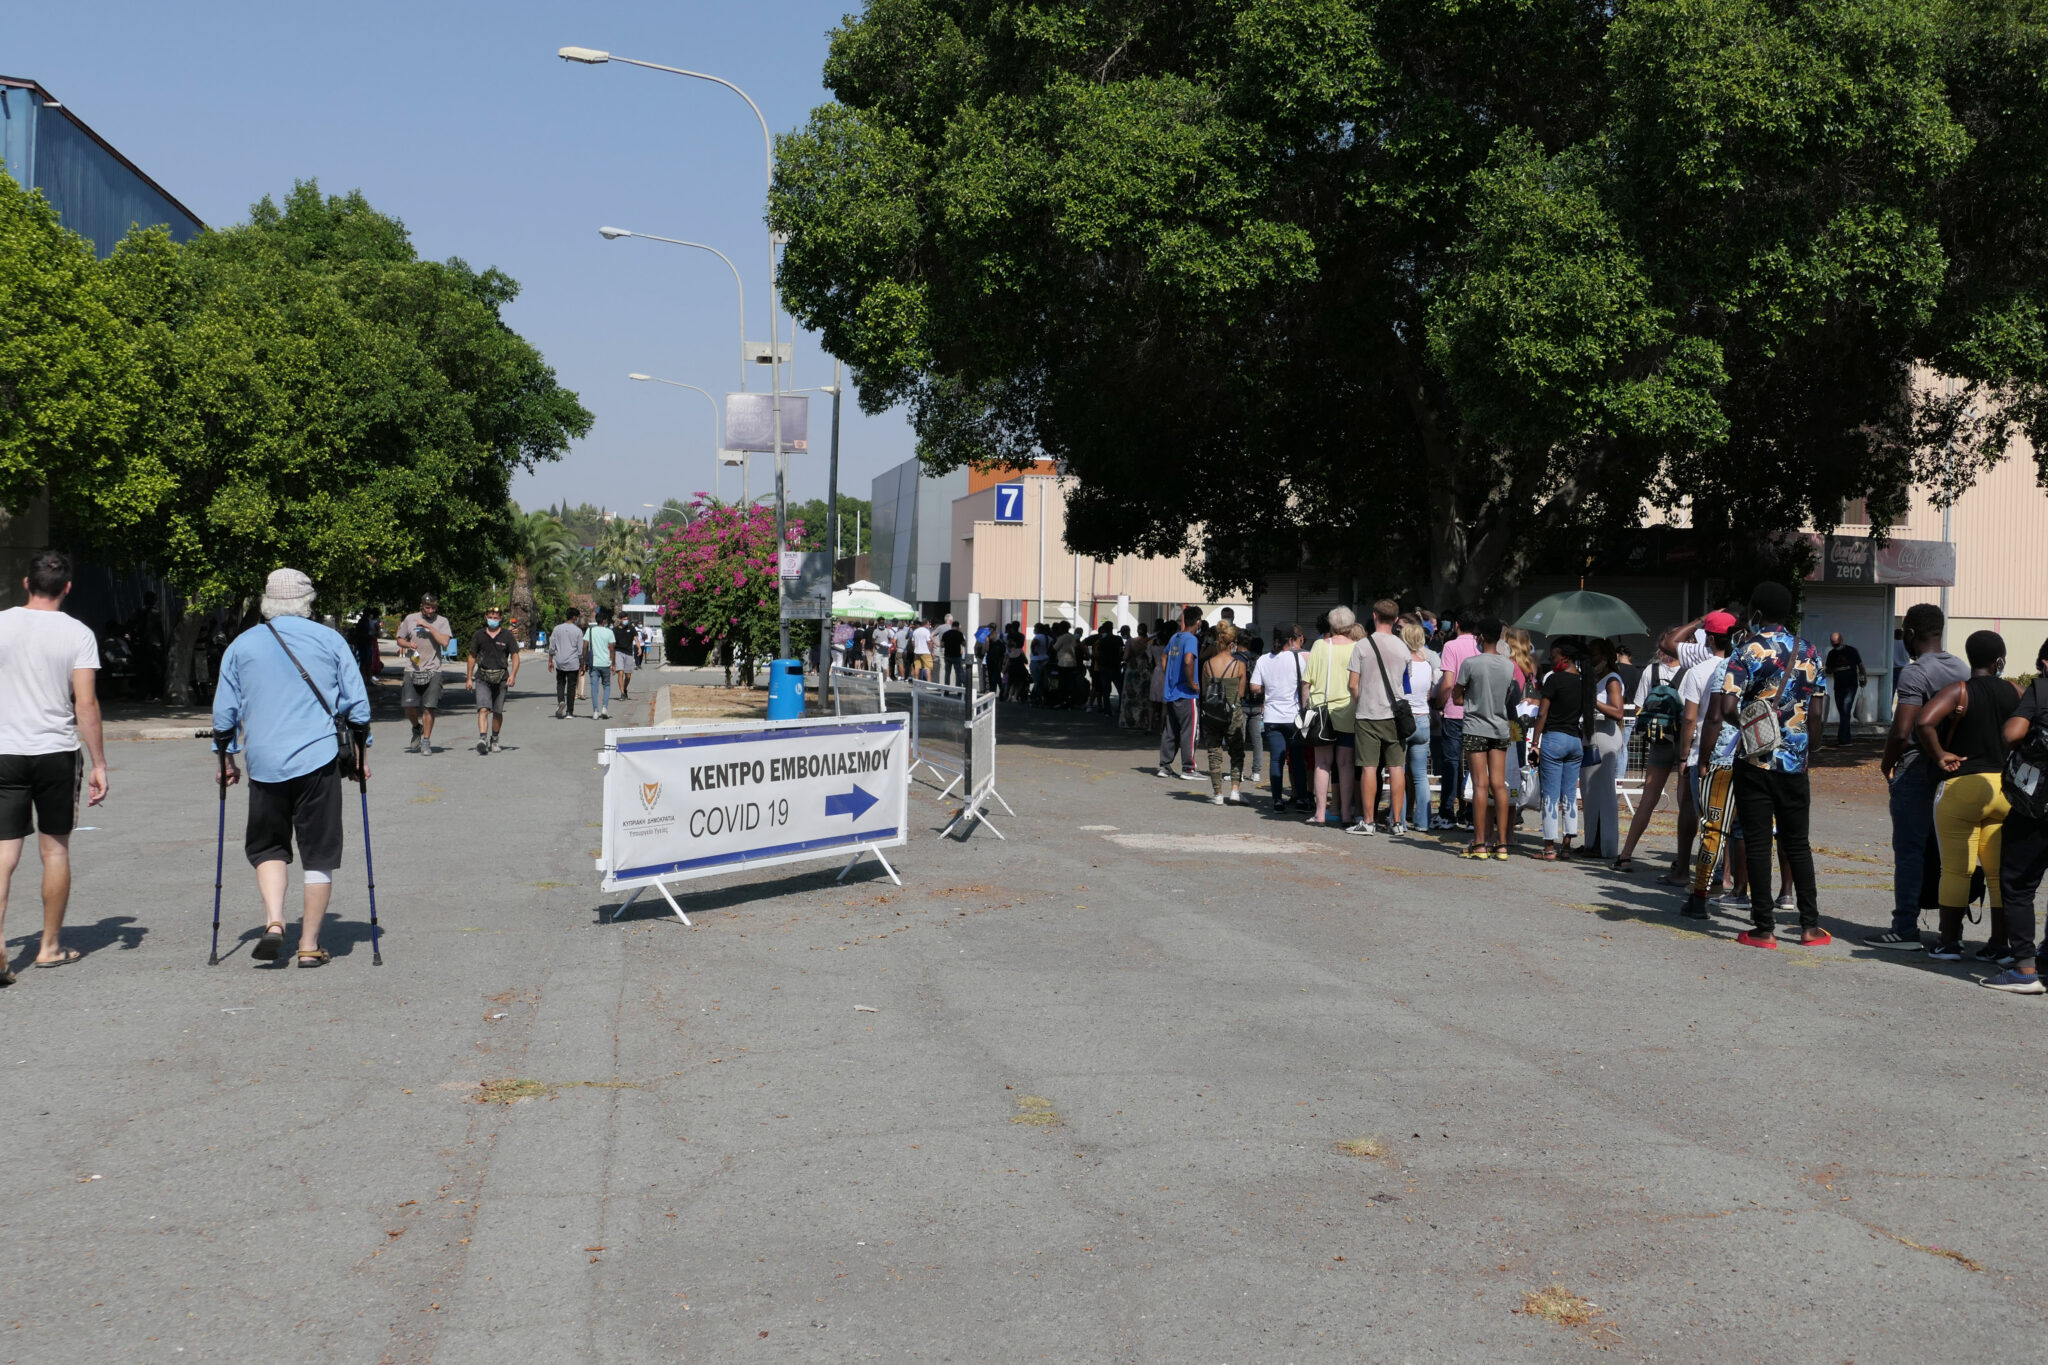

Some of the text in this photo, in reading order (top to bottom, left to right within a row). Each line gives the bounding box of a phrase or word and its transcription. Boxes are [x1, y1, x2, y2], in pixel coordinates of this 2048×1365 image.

[1001, 488, 1019, 518] 7
[1836, 565, 1862, 579] zero
[690, 748, 891, 791] ΚΕΝΤΡΟ ΕΜΒΟΛΙΑΣΜΟΥ
[689, 798, 789, 838] COVID 19
